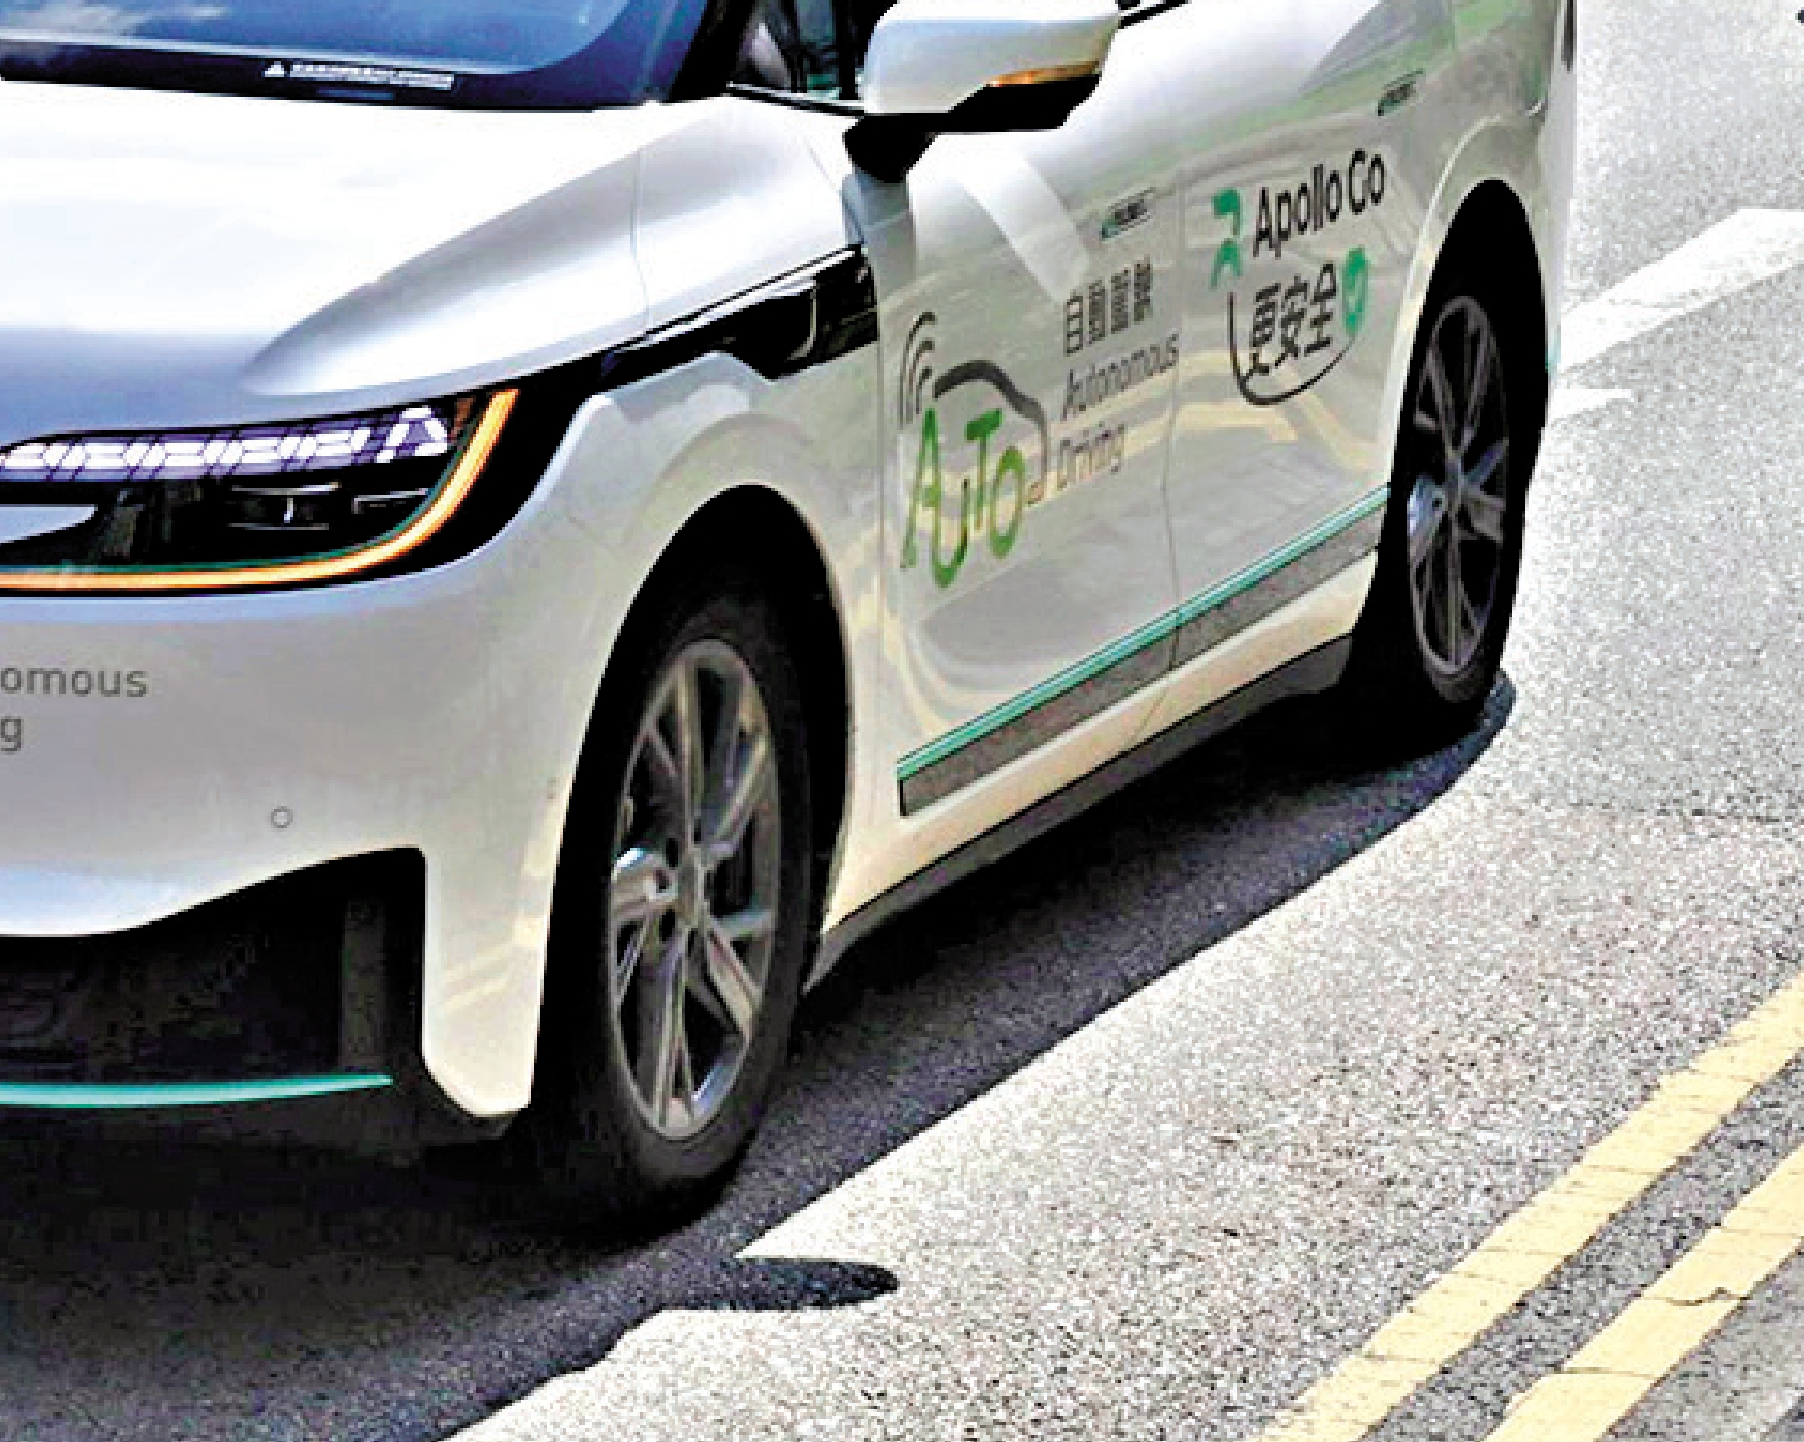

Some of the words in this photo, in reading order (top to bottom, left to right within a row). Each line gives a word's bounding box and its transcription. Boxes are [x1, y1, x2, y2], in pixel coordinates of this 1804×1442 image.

[1252, 163, 1343, 260] Apollo
[1244, 260, 1337, 377] 更安全
